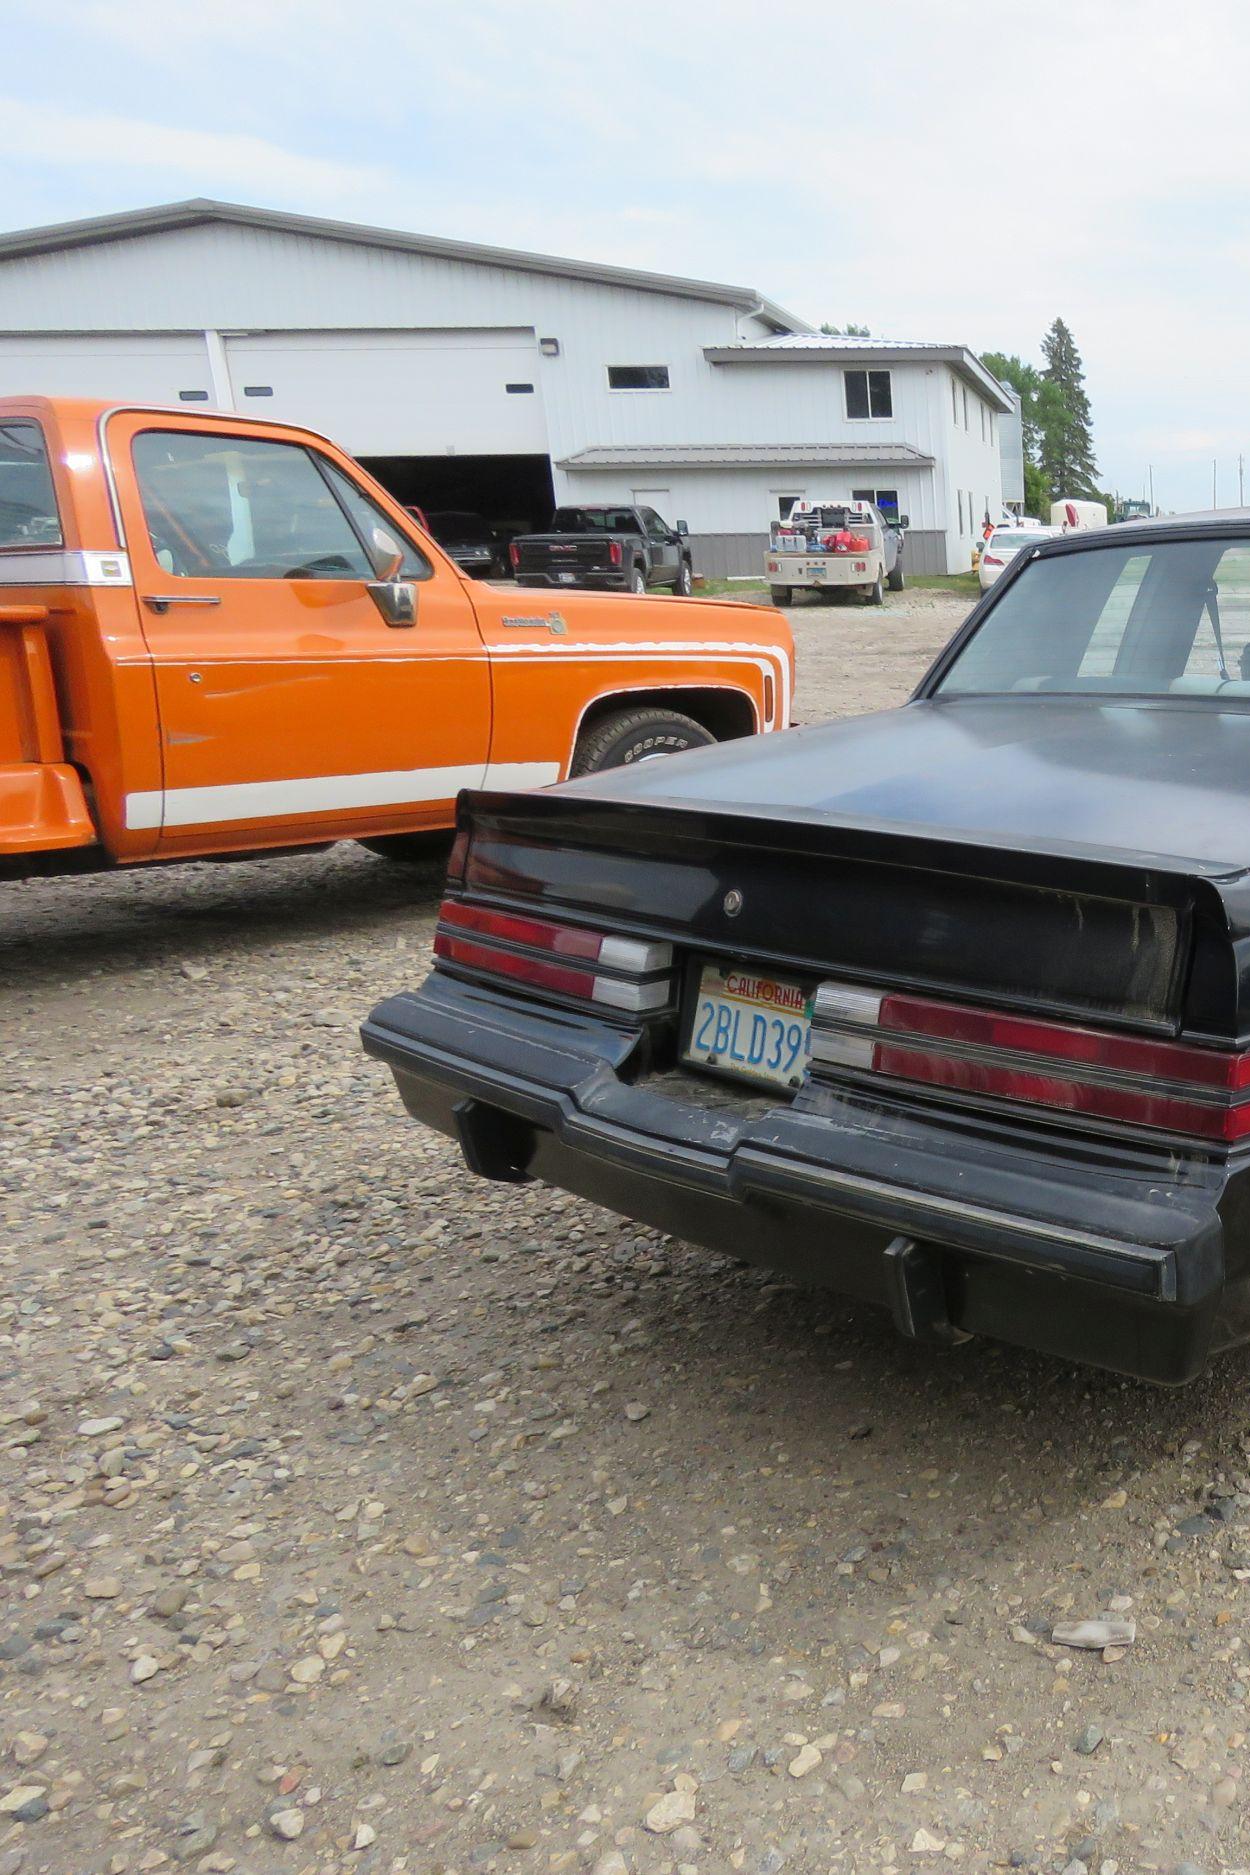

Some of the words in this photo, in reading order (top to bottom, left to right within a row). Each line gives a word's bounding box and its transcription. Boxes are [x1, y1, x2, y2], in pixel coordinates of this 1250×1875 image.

[548, 544, 578, 553] GMC
[624, 736, 689, 763] COOPER
[726, 975, 804, 1010] CALIFORNIA
[695, 1001, 812, 1074] 2BLD39
